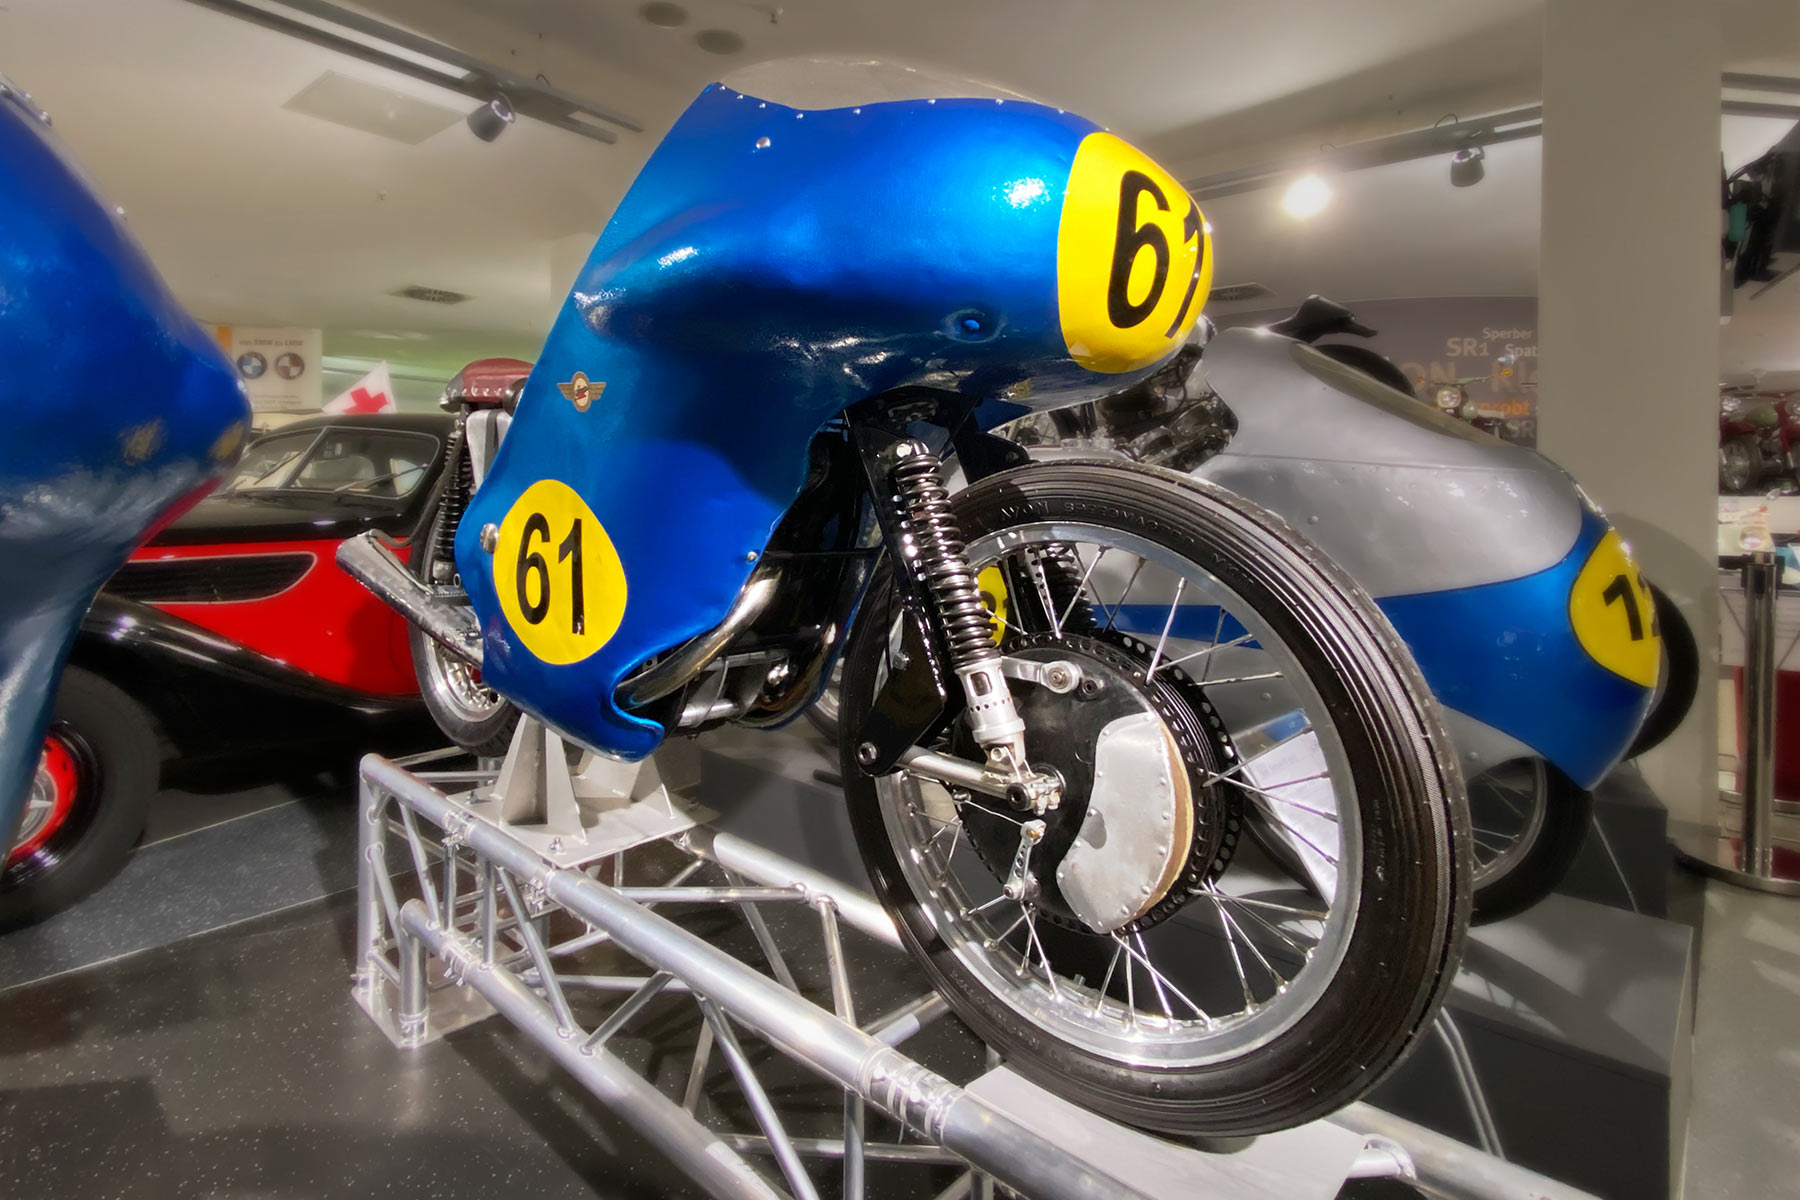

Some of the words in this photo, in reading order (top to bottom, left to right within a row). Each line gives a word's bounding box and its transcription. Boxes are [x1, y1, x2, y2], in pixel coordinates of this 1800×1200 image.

[1107, 170, 1205, 339] 61
[1446, 337, 1490, 358] SR1
[1482, 327, 1533, 341] Sperber
[516, 512, 585, 636] 61
